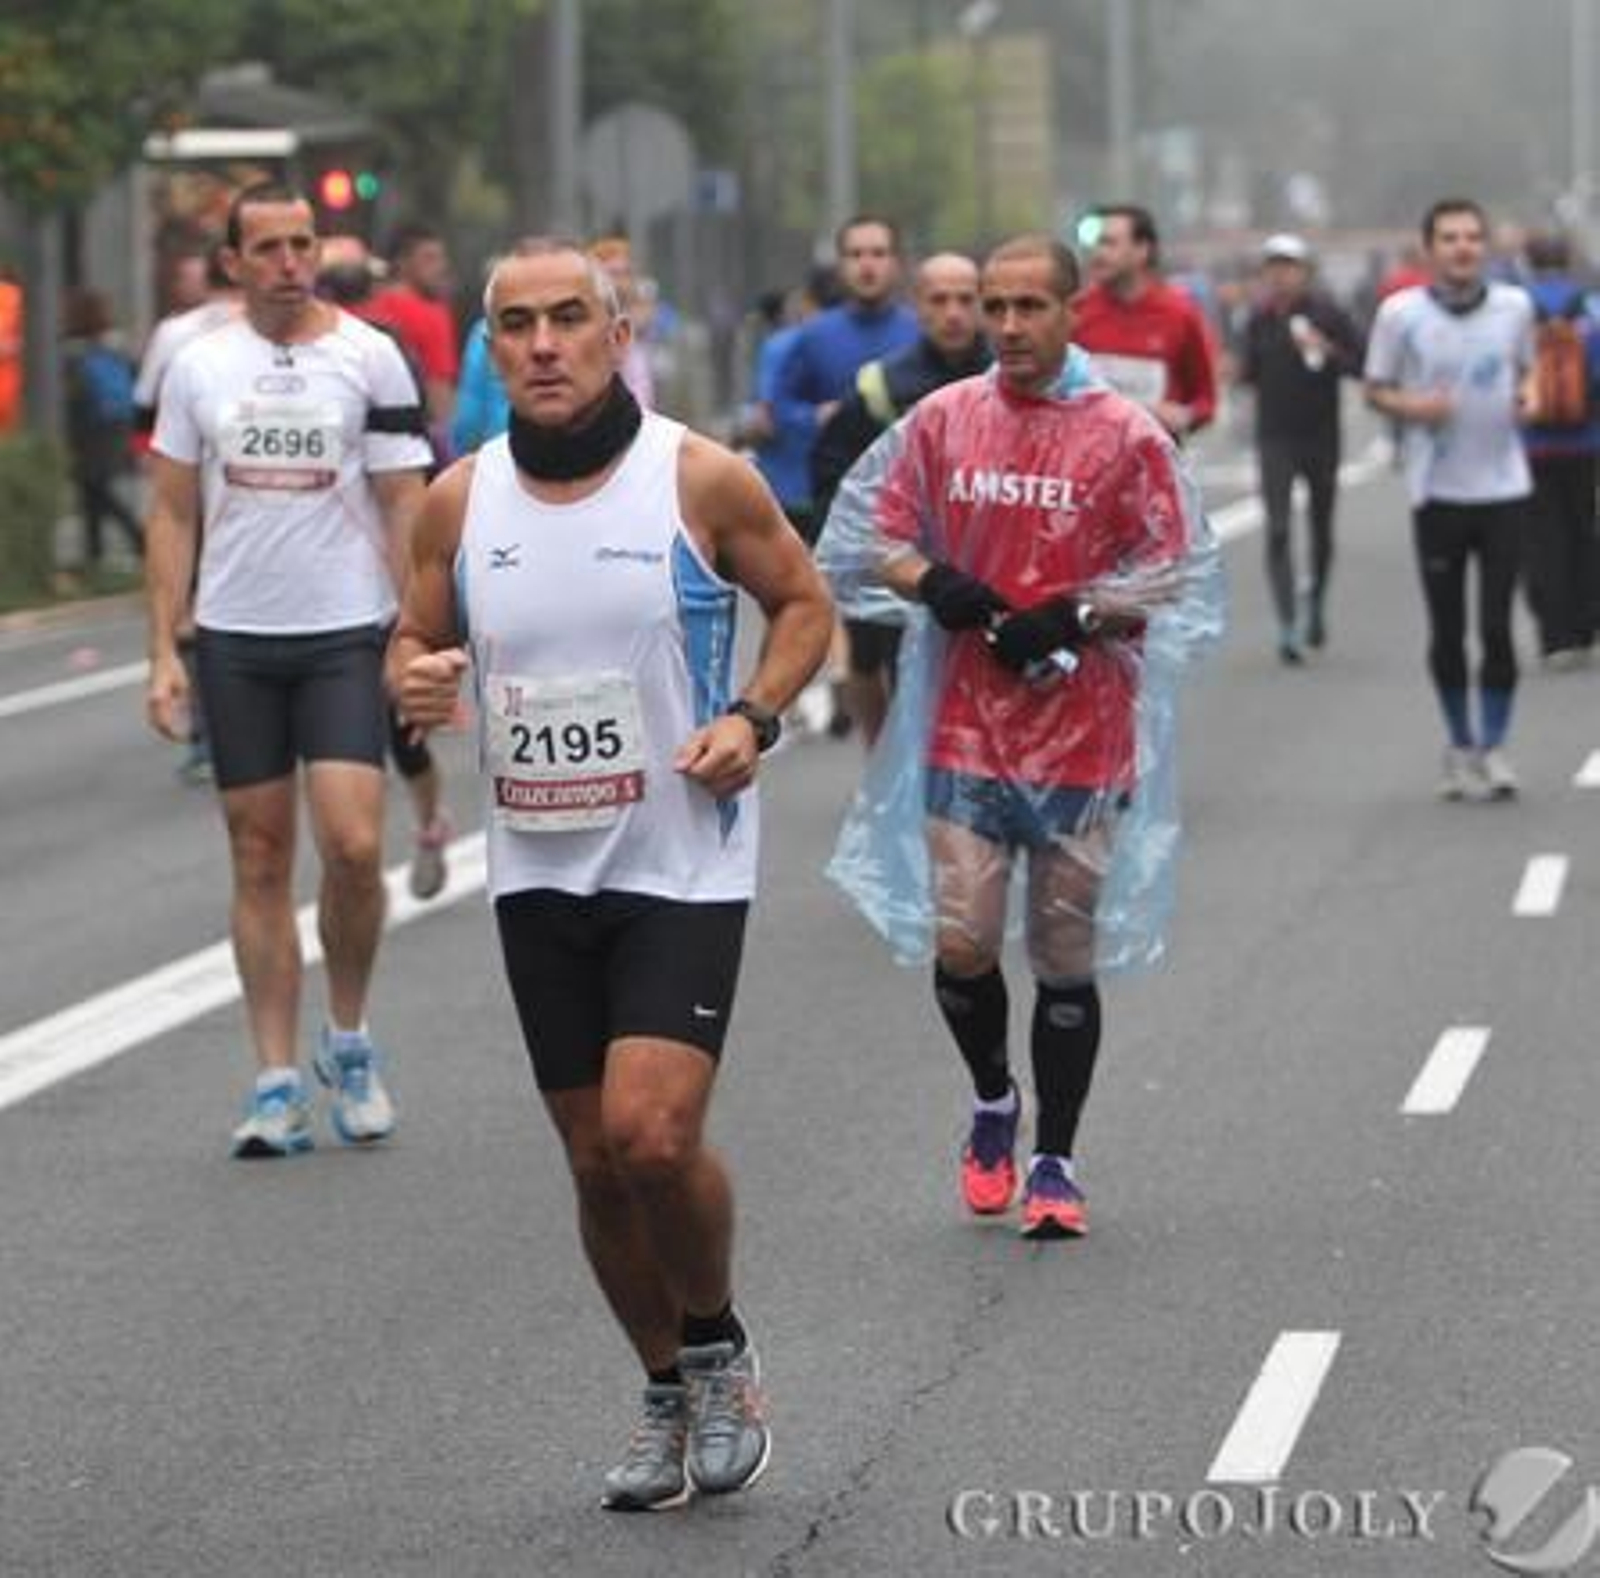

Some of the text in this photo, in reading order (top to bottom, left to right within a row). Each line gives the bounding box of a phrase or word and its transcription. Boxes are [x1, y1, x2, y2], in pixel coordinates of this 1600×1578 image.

[242, 426, 325, 458] 2696
[948, 467, 1076, 511] AMSTEL
[511, 719, 622, 764] 2195
